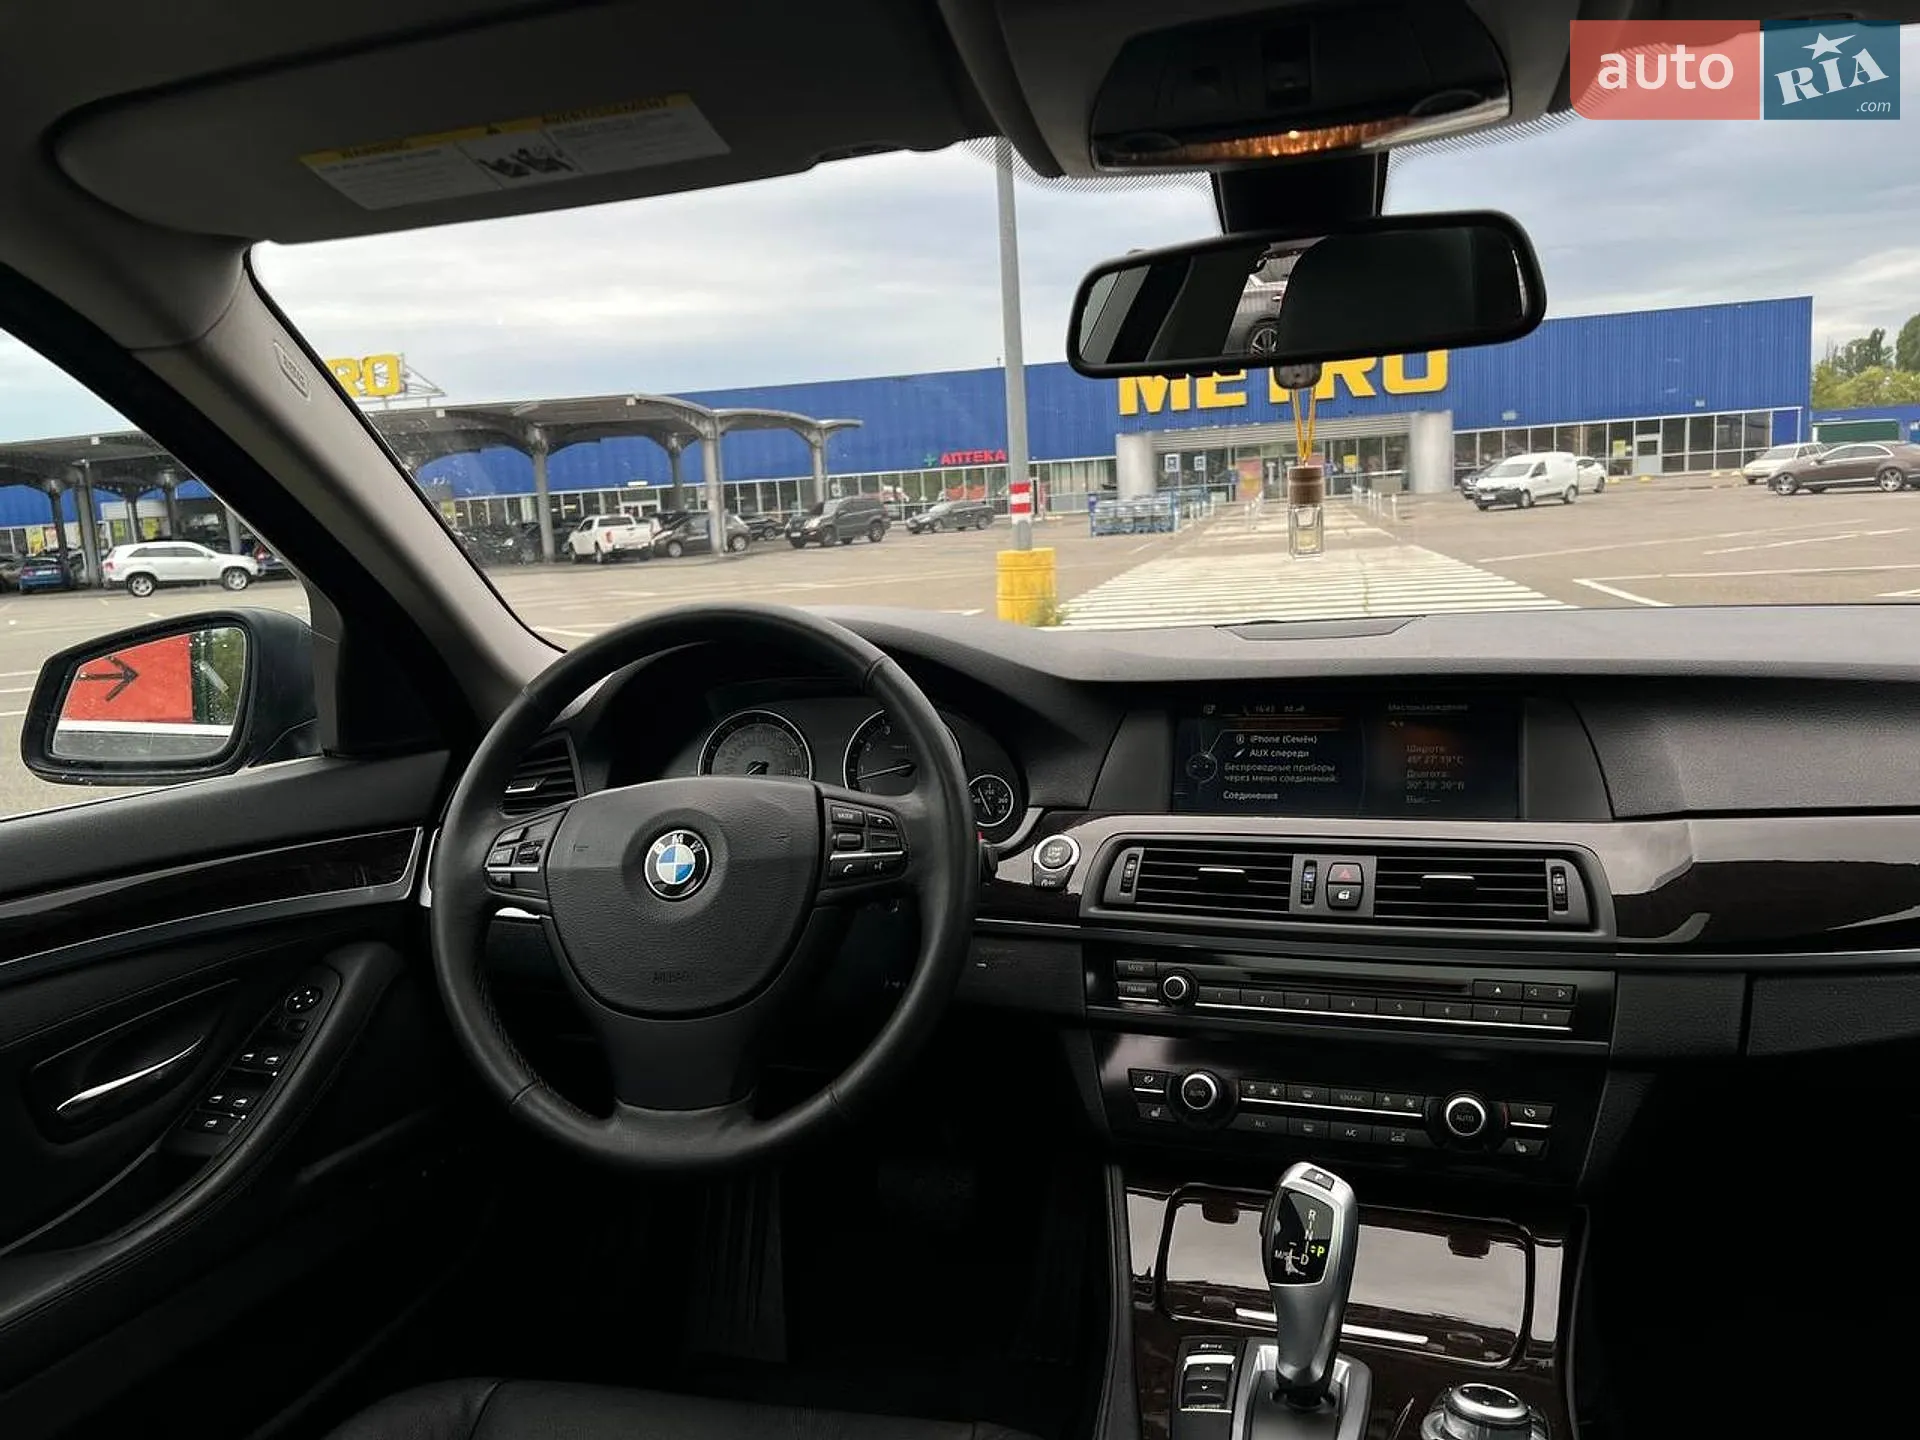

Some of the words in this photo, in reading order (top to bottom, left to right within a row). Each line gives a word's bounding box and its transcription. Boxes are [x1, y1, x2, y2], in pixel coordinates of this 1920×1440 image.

[940, 449, 1007, 465] АПТЕКА
[1249, 734, 1280, 744] iPhone
[1249, 749, 1269, 758] AUX
[1270, 750, 1310, 759] спереди
[654, 834, 704, 855] BMW
[1308, 1209, 1317, 1222] R
[1316, 1246, 1326, 1258] P
[1300, 1253, 1309, 1267] D
